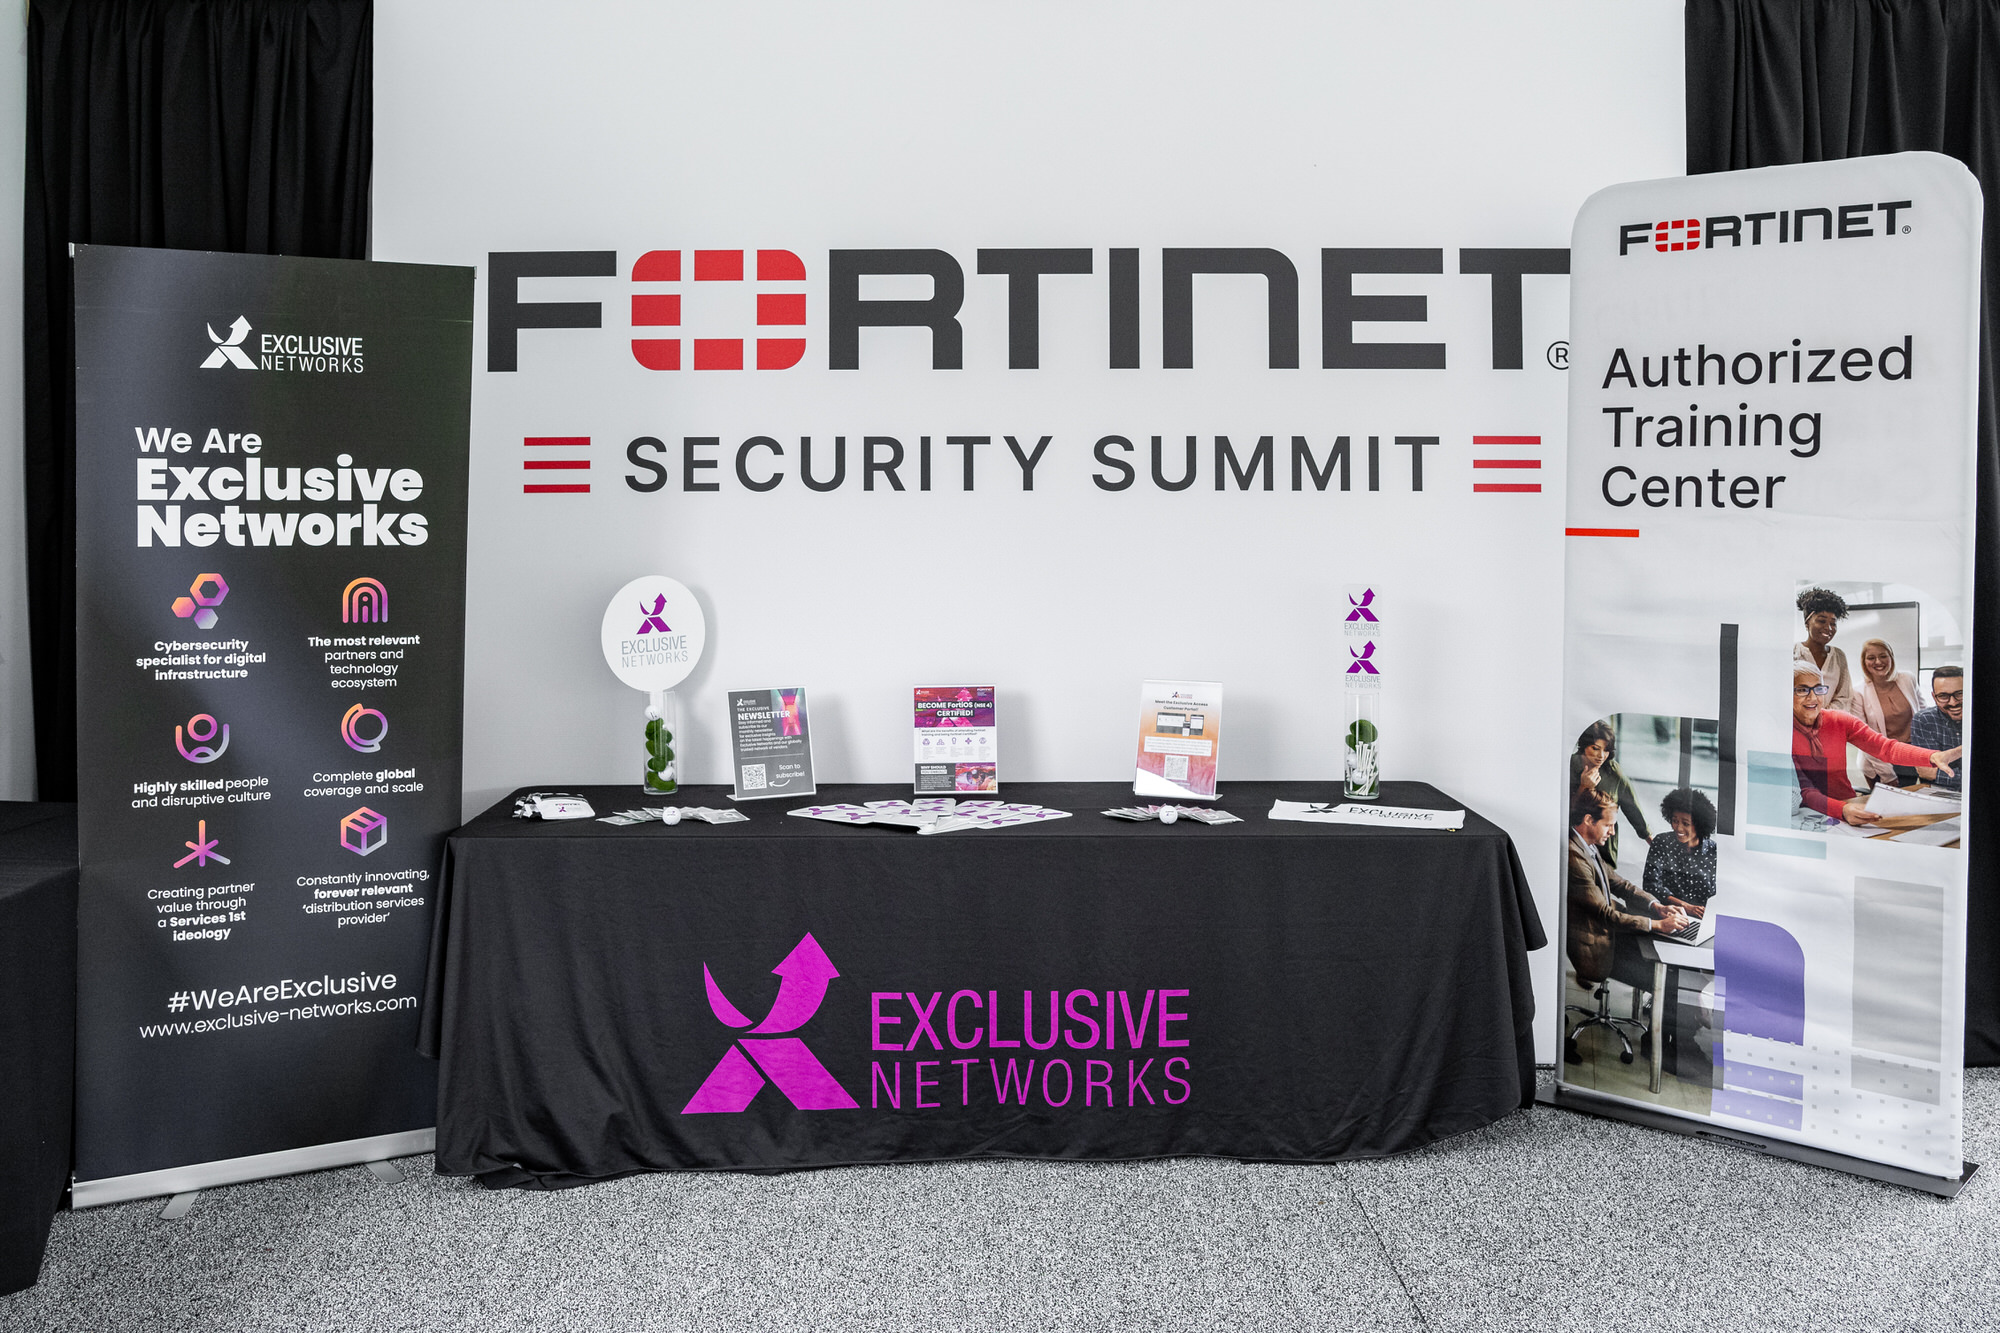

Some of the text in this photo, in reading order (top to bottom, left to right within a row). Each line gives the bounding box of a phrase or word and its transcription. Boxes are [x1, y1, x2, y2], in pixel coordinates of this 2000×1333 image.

[1620, 200, 1912, 256] FORTINET
[262, 334, 363, 356] EXCLUSIVE
[262, 355, 363, 373] NETWORKS
[1602, 335, 1912, 389] Authorized
[135, 426, 262, 453] We Are
[1602, 403, 1821, 458] Training
[625, 434, 1440, 494] SECURITY SUMMIT
[137, 454, 423, 501] Exclusive
[1601, 466, 1786, 509] Center
[137, 504, 428, 547] Networks
[154, 639, 248, 653] Cybersecurity
[308, 635, 420, 647] The most relevant
[621, 635, 687, 655] EXCLUSIVE
[136, 652, 266, 670] specialist for digital
[325, 649, 404, 663] partners and
[622, 650, 688, 668] NETWORKS
[155, 668, 248, 680] infrastructure
[330, 663, 398, 677] technology
[1345, 675, 1380, 683] EXCLUSIVE
[332, 677, 397, 690] ecosystem
[738, 711, 790, 720] NEWSLETTER
[313, 768, 415, 785] Complete global
[776, 771, 805, 779] subscribe!
[134, 776, 269, 796] Highly skilled people
[304, 781, 424, 798] coverage and scale
[132, 790, 271, 808] and disruptive culture
[297, 868, 429, 887] Constantly innovating,
[148, 882, 255, 900] Creating partner
[314, 883, 413, 899] forever relevant
[157, 897, 246, 913] value through
[376, 896, 424, 909] services
[158, 911, 246, 928] a Services 1st
[173, 928, 231, 941] ideology
[168, 971, 397, 1012] #WeAreExclusive
[140, 995, 417, 1038] www.exclusive-networks.com
[871, 989, 1190, 1051] EXCLUSIVE
[872, 1056, 1192, 1109] NETWORKS
